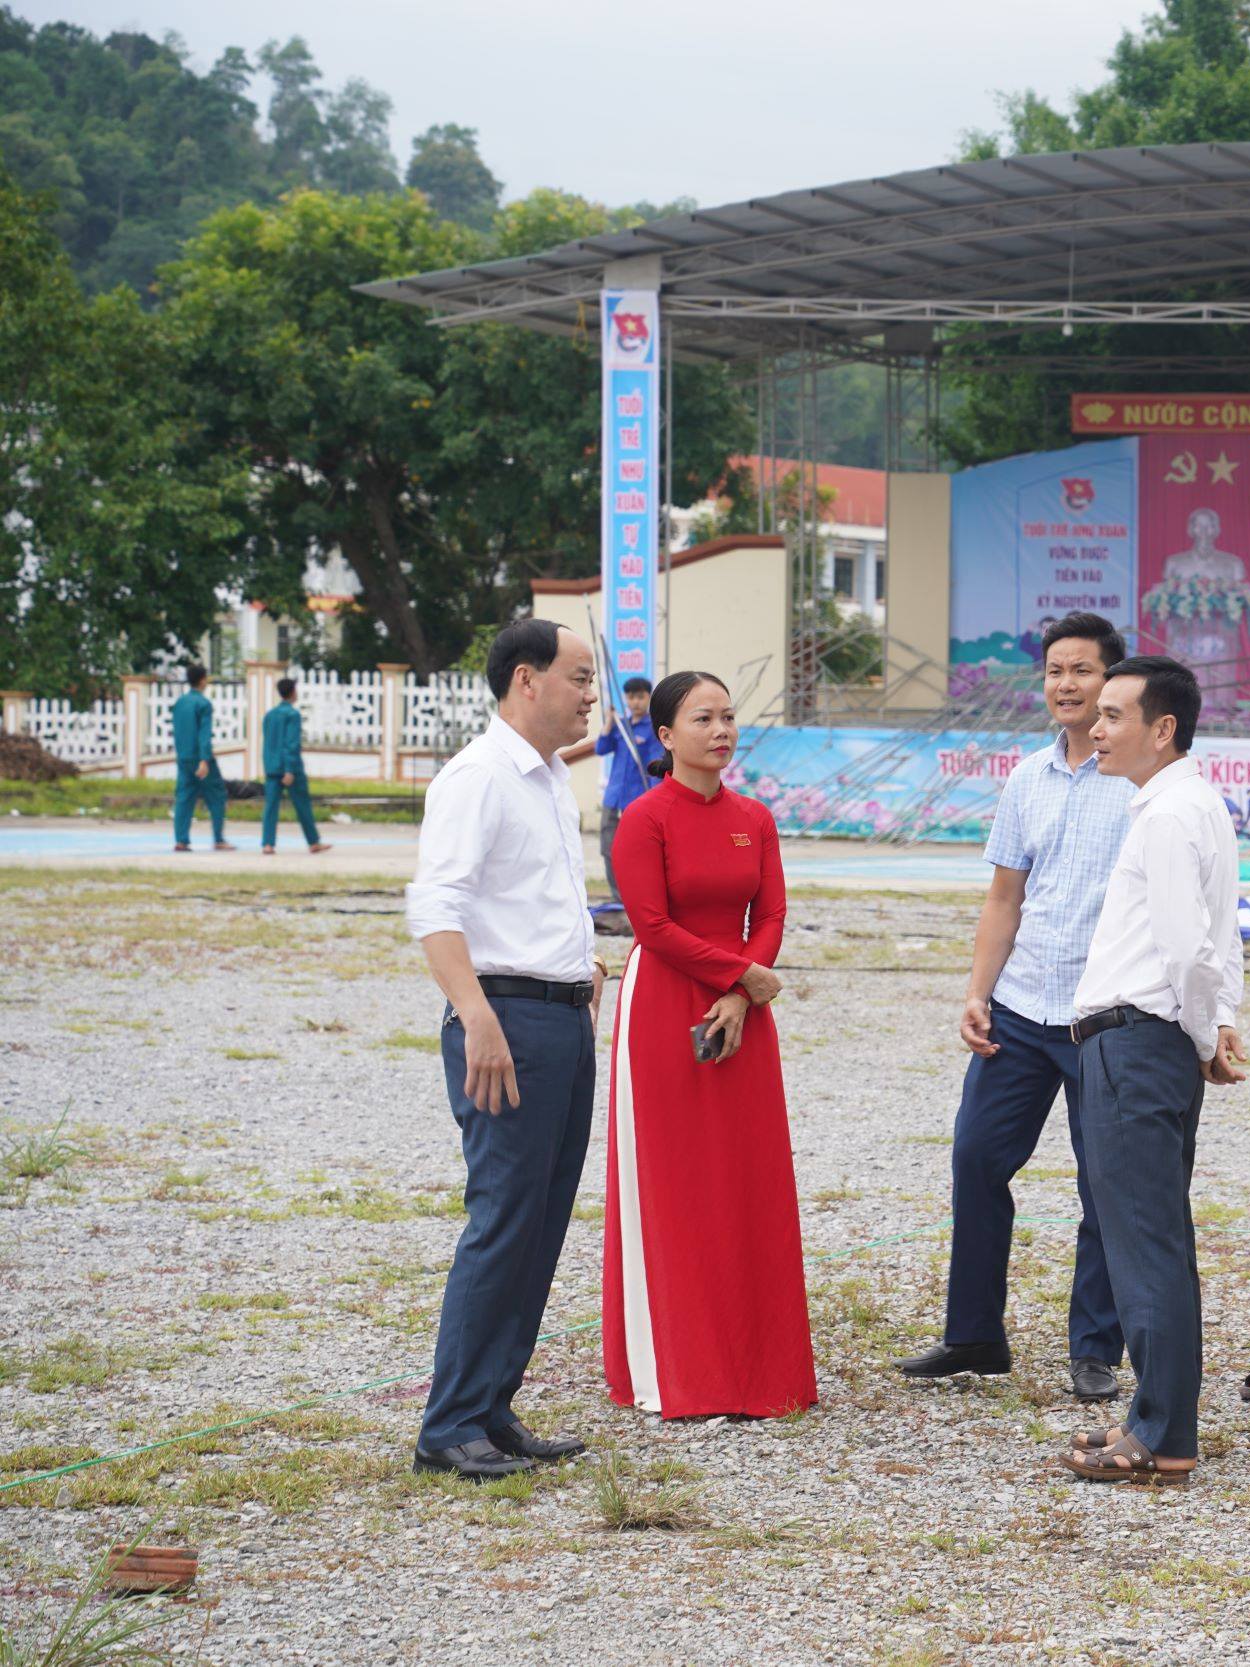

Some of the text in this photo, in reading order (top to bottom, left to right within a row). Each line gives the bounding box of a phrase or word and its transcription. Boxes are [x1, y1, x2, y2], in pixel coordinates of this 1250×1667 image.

[618, 389, 643, 416] TUỔI
[1123, 401, 1195, 425] NƯỚC
[621, 423, 641, 448] TRẺ
[620, 461, 645, 481] NHƯ
[616, 489, 646, 513] XUÂN
[623, 522, 640, 548] TỰ
[620, 553, 644, 577] HÀO
[618, 584, 643, 609] TIẾN
[616, 617, 646, 641] BƯỚC
[938, 742, 983, 777] TUỔI
